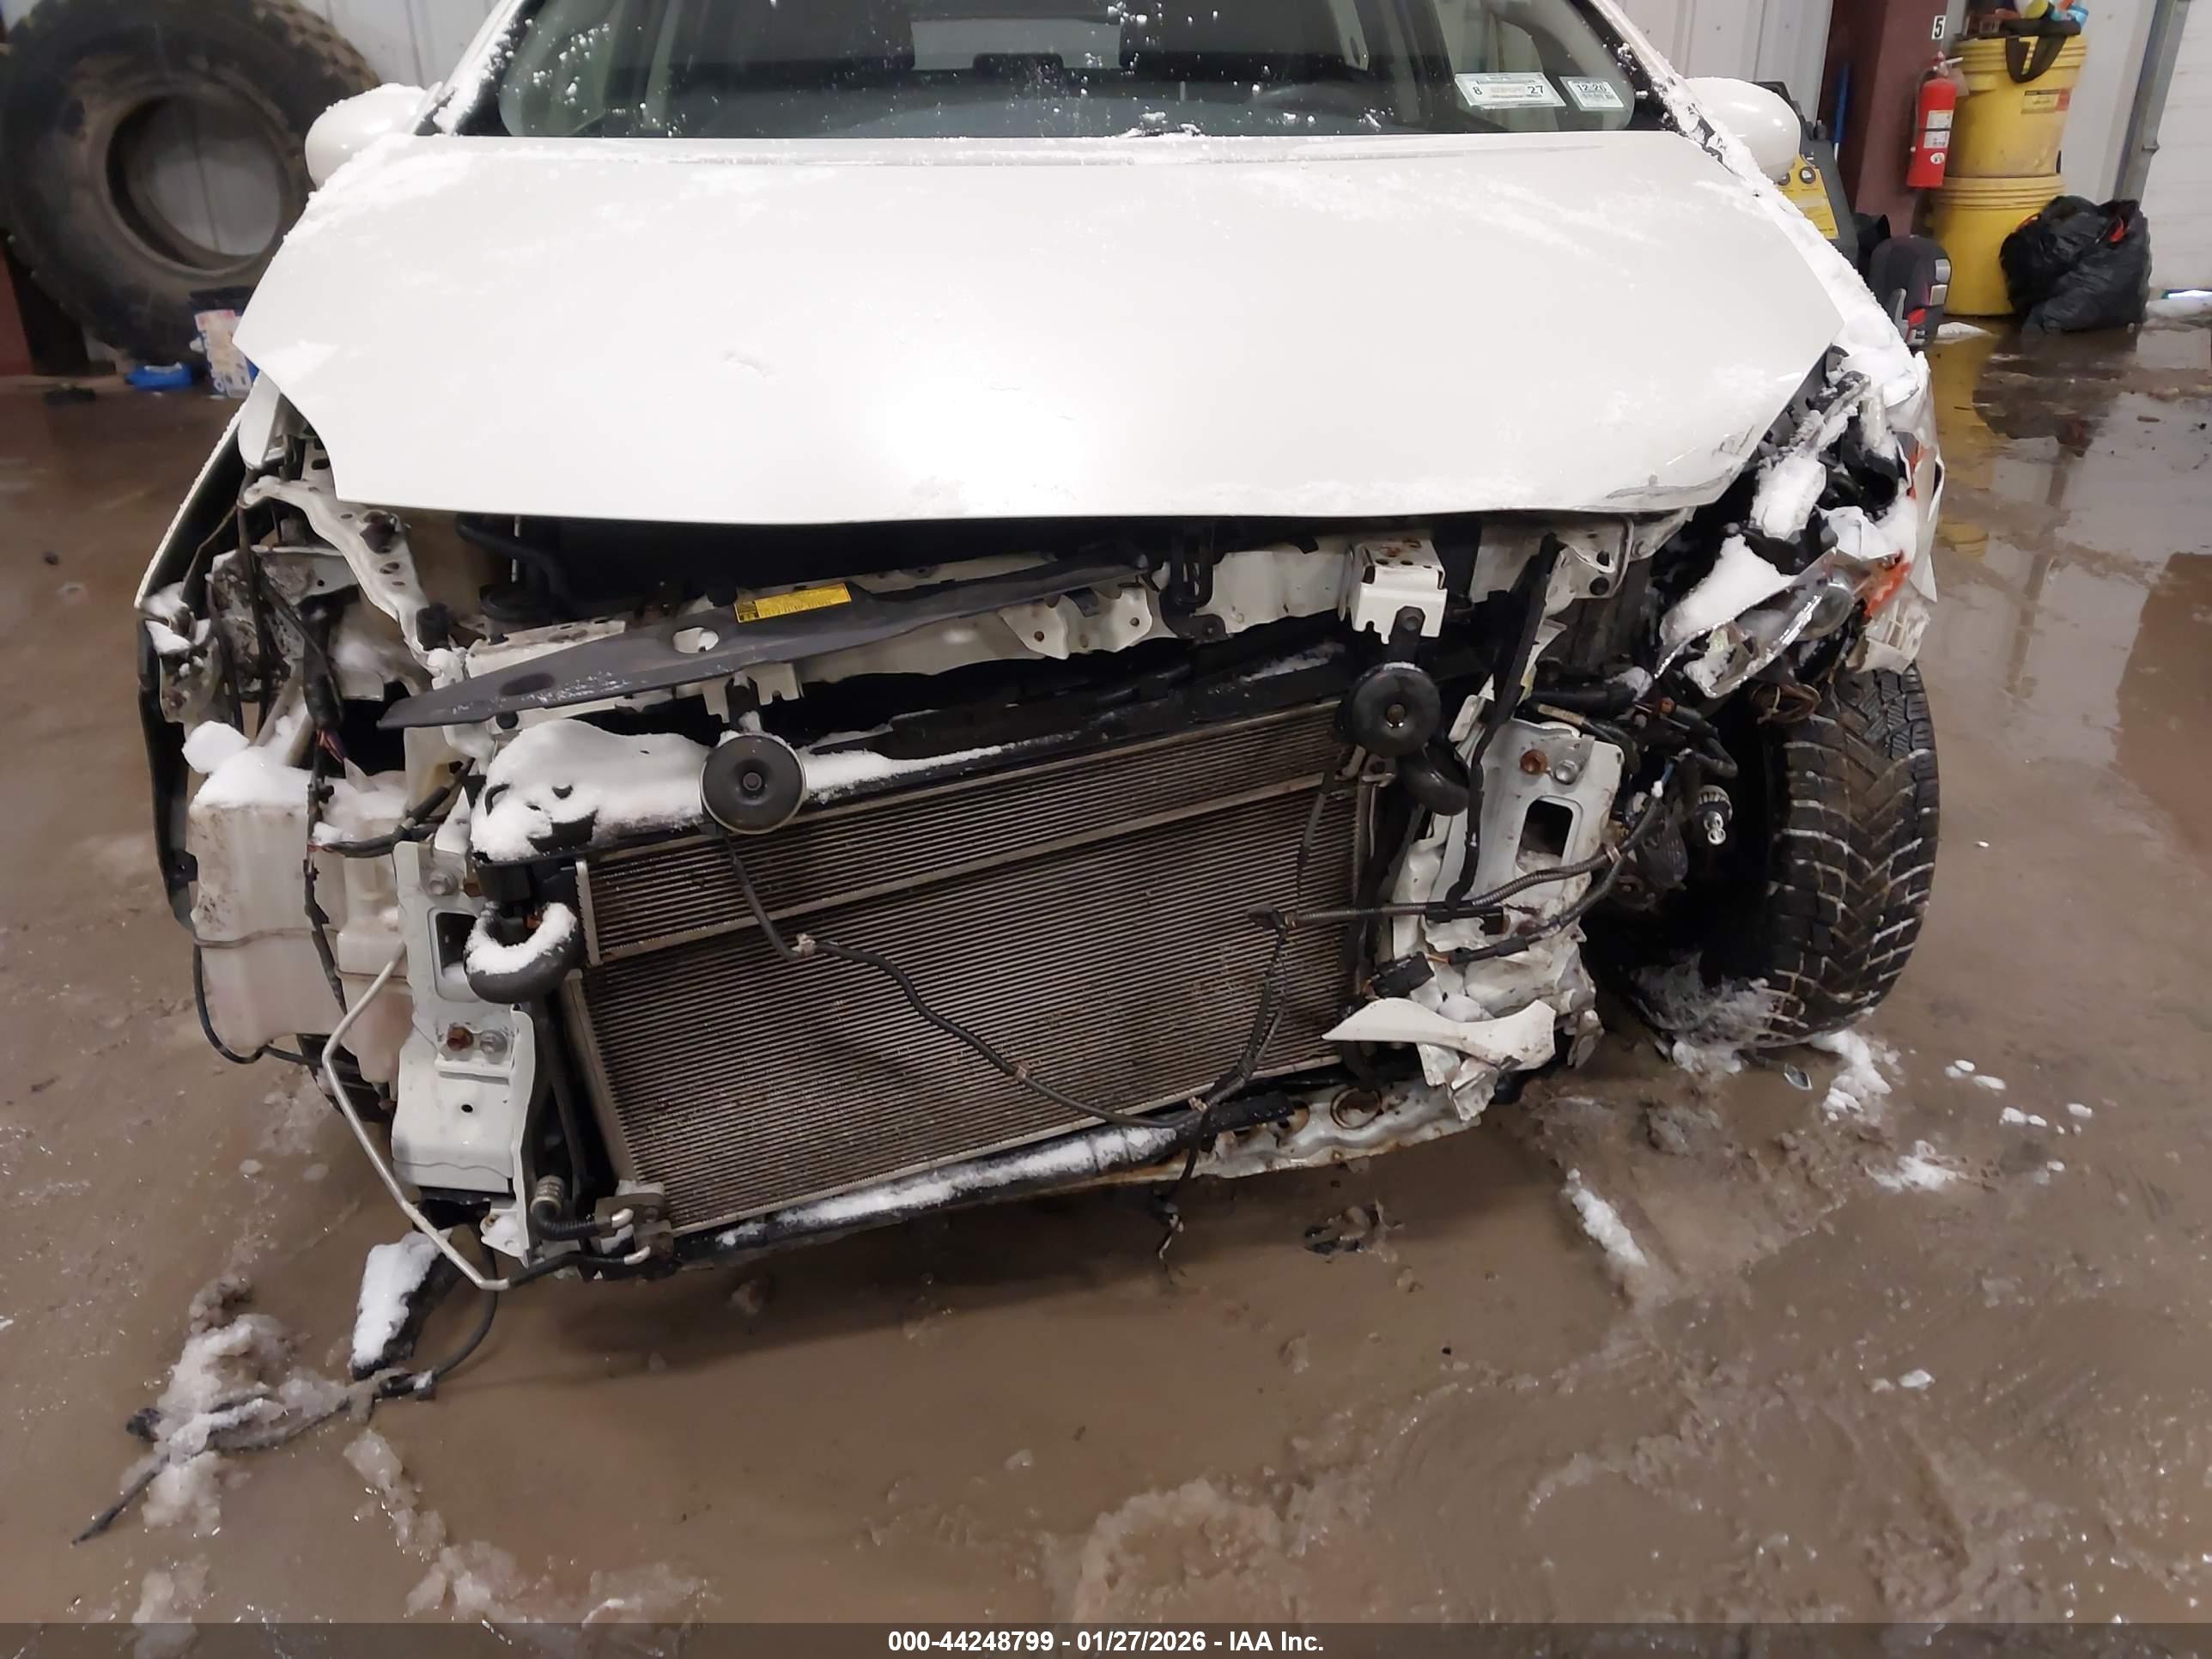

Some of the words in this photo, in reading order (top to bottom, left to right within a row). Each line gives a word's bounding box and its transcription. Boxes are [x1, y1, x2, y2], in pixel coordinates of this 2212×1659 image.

[1935, 17, 1943, 37] 5
[1473, 87, 1482, 95] 8
[1527, 85, 1544, 94] 27
